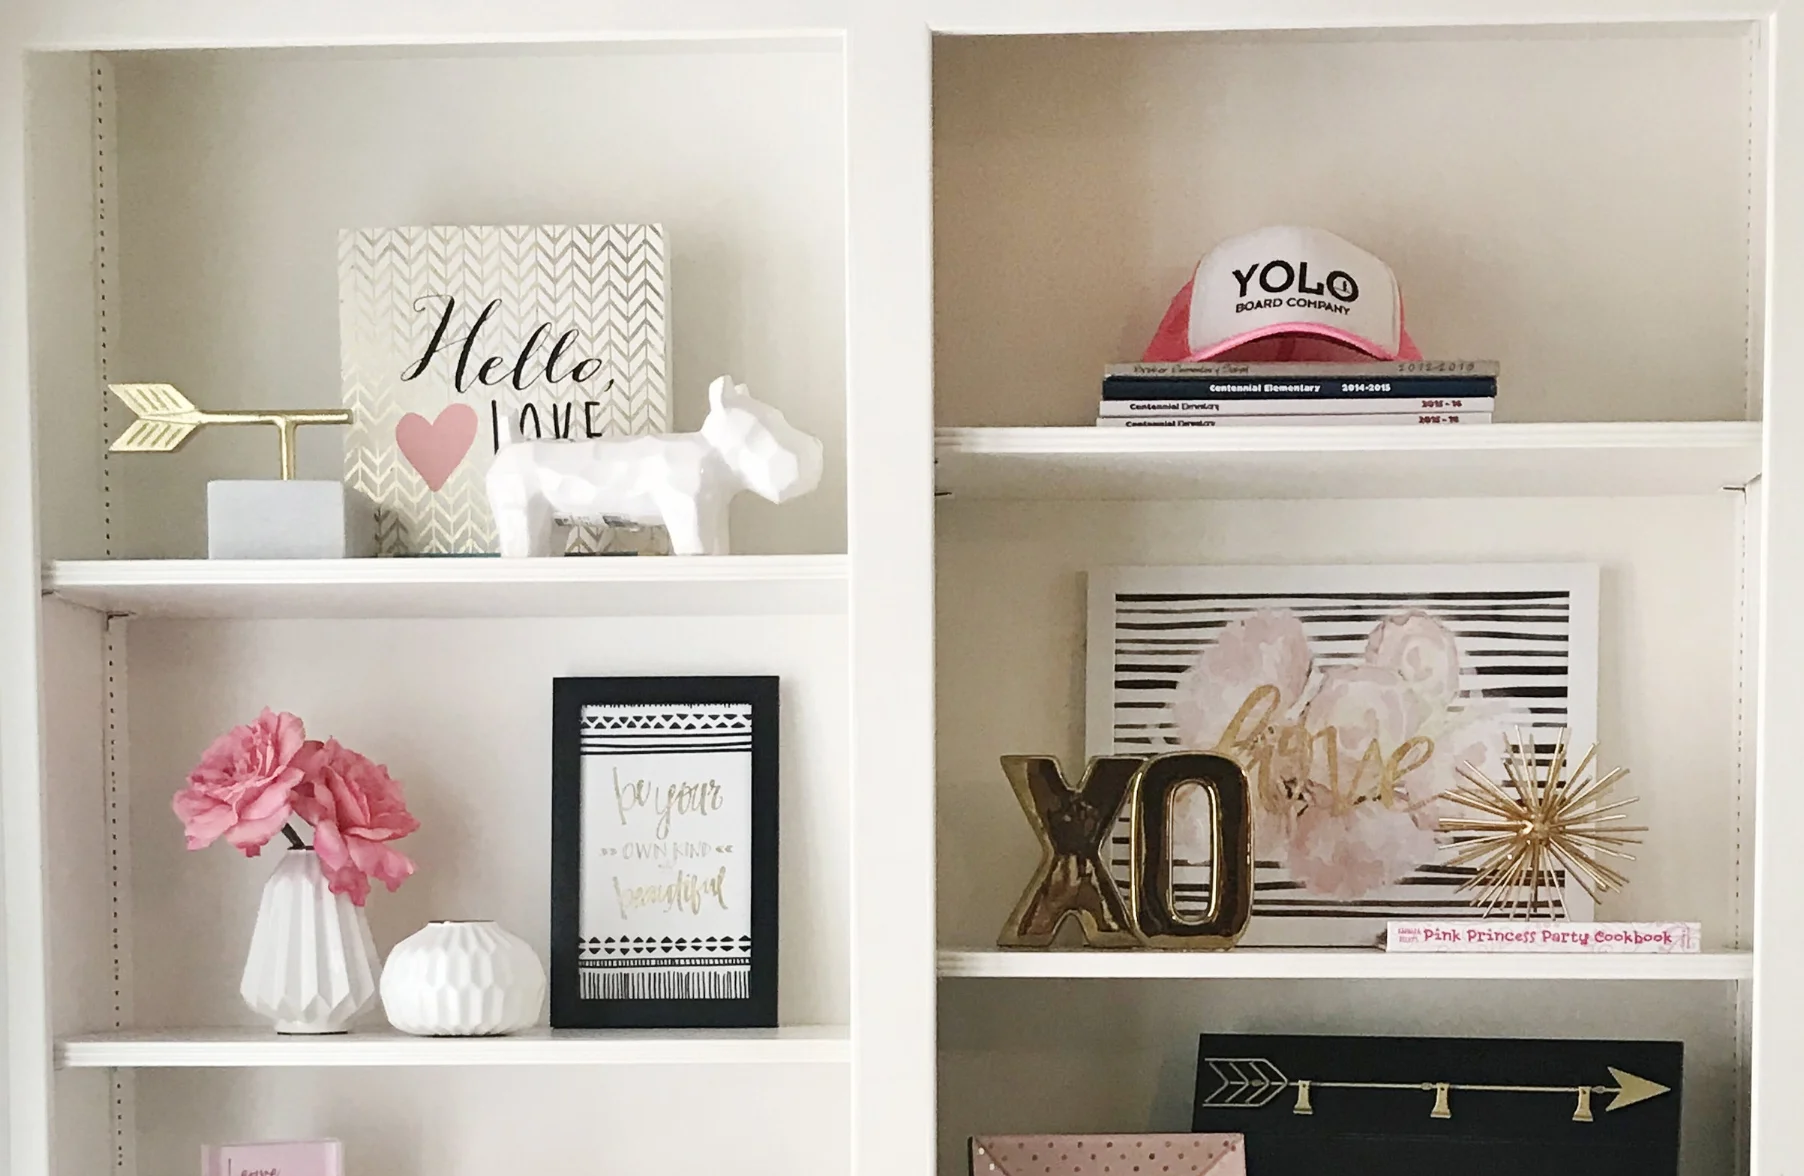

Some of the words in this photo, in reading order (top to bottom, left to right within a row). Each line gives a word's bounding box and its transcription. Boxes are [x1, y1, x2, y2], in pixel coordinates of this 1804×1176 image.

[1232, 259, 1359, 303] YOLO
[1235, 298, 1283, 313] BOARD
[1286, 298, 1350, 315] COMPANY
[400, 294, 615, 393] Hello,
[1209, 384, 1261, 393] Centennial
[1264, 384, 1320, 394] Elementary
[1342, 383, 1391, 393] 2014-2015
[612, 766, 651, 825] be
[655, 778, 723, 840] your
[622, 842, 667, 860] OWN
[673, 841, 712, 861] KIND
[997, 750, 1254, 952] XO
[612, 865, 729, 920] beautiful
[1423, 928, 1462, 943] Pink
[1467, 928, 1537, 943] Princess
[1542, 930, 1590, 945] Party
[1594, 930, 1673, 945] Cookbook
